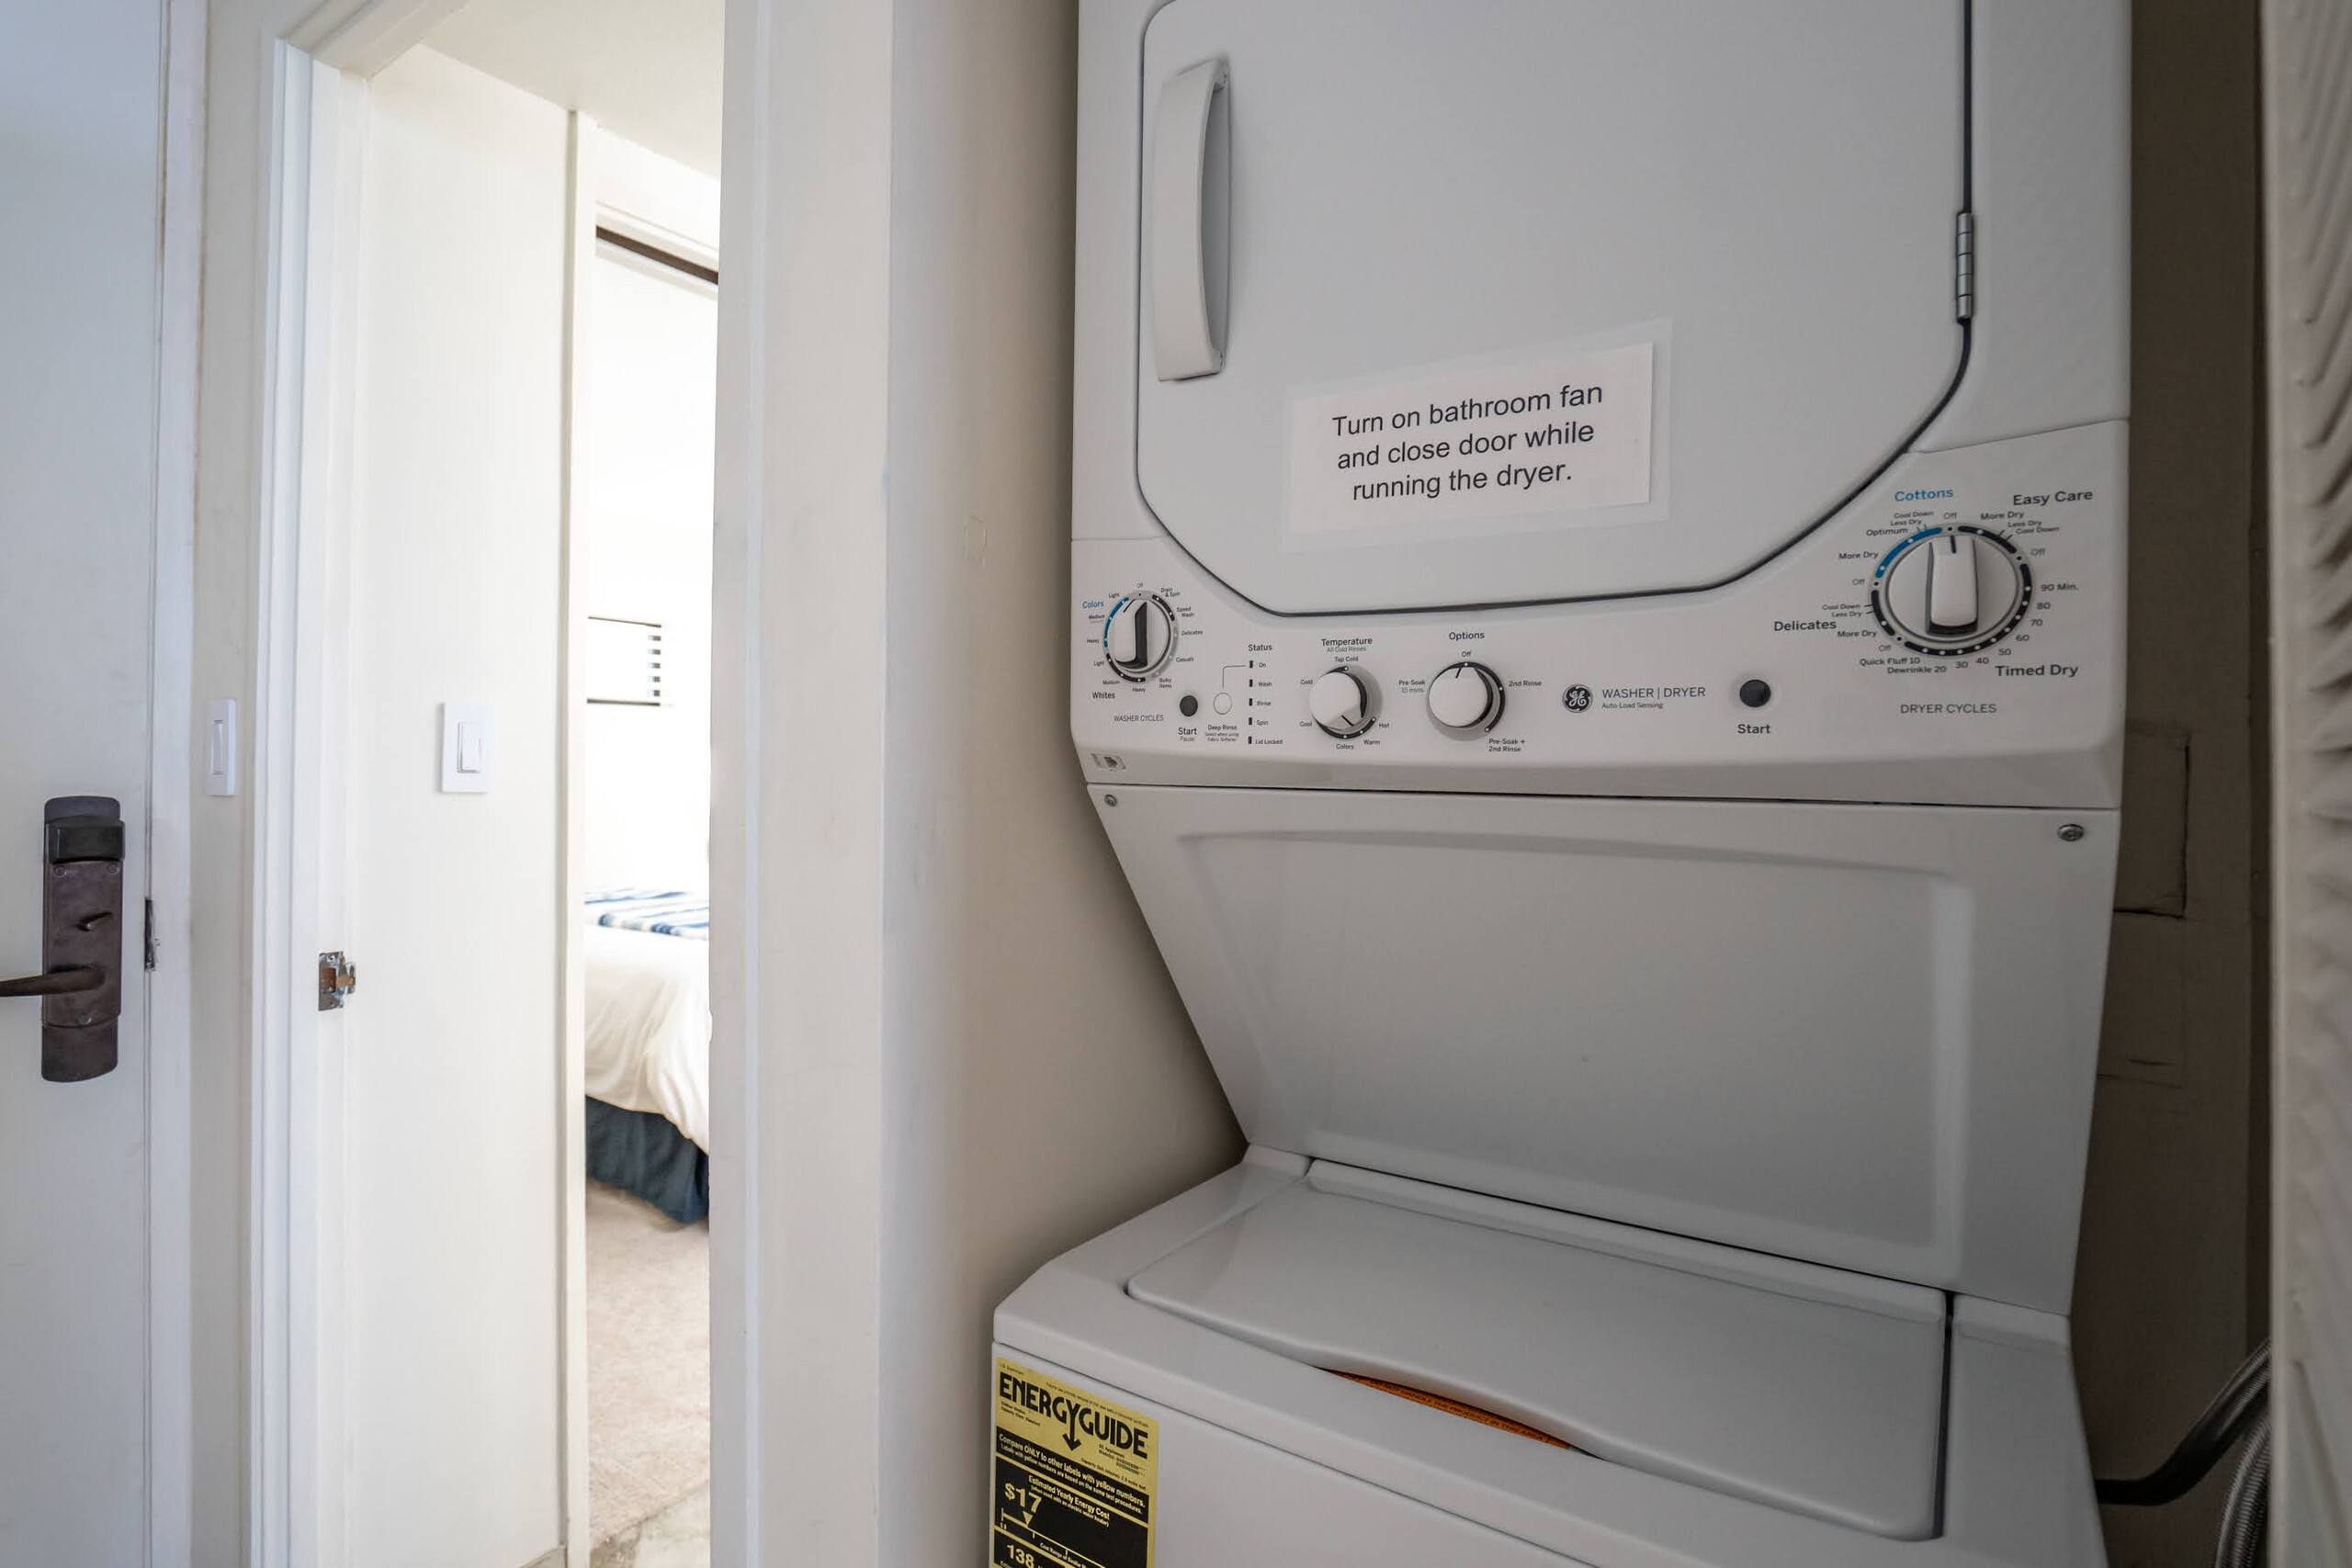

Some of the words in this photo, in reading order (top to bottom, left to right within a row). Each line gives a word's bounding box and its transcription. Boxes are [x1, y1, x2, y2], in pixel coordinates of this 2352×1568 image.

[1332, 415, 1383, 436] Turn
[1391, 412, 1420, 429] on
[1429, 393, 1550, 424] bathroom
[1560, 385, 1602, 408] fan
[1338, 446, 1379, 468] and
[1387, 441, 1450, 464] close
[1459, 433, 1517, 456] door
[1525, 421, 1594, 447] while
[1353, 474, 1441, 500] running
[1449, 468, 1487, 491] the
[1497, 463, 1572, 489] dryer.
[1895, 489, 1953, 502] Cottons
[2013, 494, 2051, 506] Easy
[2054, 491, 2093, 502] Care
[2007, 511, 2024, 519] Dry
[1866, 528, 1908, 536] Optimum
[1839, 552, 1860, 560] More
[1082, 601, 1104, 609] Colors
[1774, 619, 1837, 631] Delicates
[1449, 631, 1486, 641] Options
[1861, 629, 1876, 637] Dry
[1321, 637, 1373, 647] Temperature
[1860, 658, 1884, 667] Quick
[1887, 666, 1932, 674] Dewrinkle
[1995, 664, 2044, 676] Timed
[2051, 664, 2078, 678] Dry
[1602, 688, 1654, 699] WASHER
[1663, 687, 1706, 698] DRYER
[1901, 704, 1942, 714] DRYER
[1946, 704, 1997, 714] CYCLES
[1737, 723, 1771, 734] Start
[1000, 1371, 1148, 1460] ENERGYGUIDE
[999, 1434, 1023, 1451] Compare
[1024, 1445, 1040, 1458] ONLY
[1041, 1452, 1047, 1461] to
[1047, 1457, 1063, 1469] other
[1063, 1463, 1081, 1477] labels
[1082, 1473, 1095, 1483] with
[1095, 1479, 1115, 1494] yellow
[1115, 1488, 1146, 1507] numbers.
[1005, 1483, 1042, 1513] $17
[1028, 1475, 1056, 1493] Estimated
[1057, 1488, 1074, 1504] Yearly
[1074, 1497, 1095, 1514] Energy
[1095, 1507, 1110, 1520] Cost
[1007, 1544, 1035, 1568] 138
